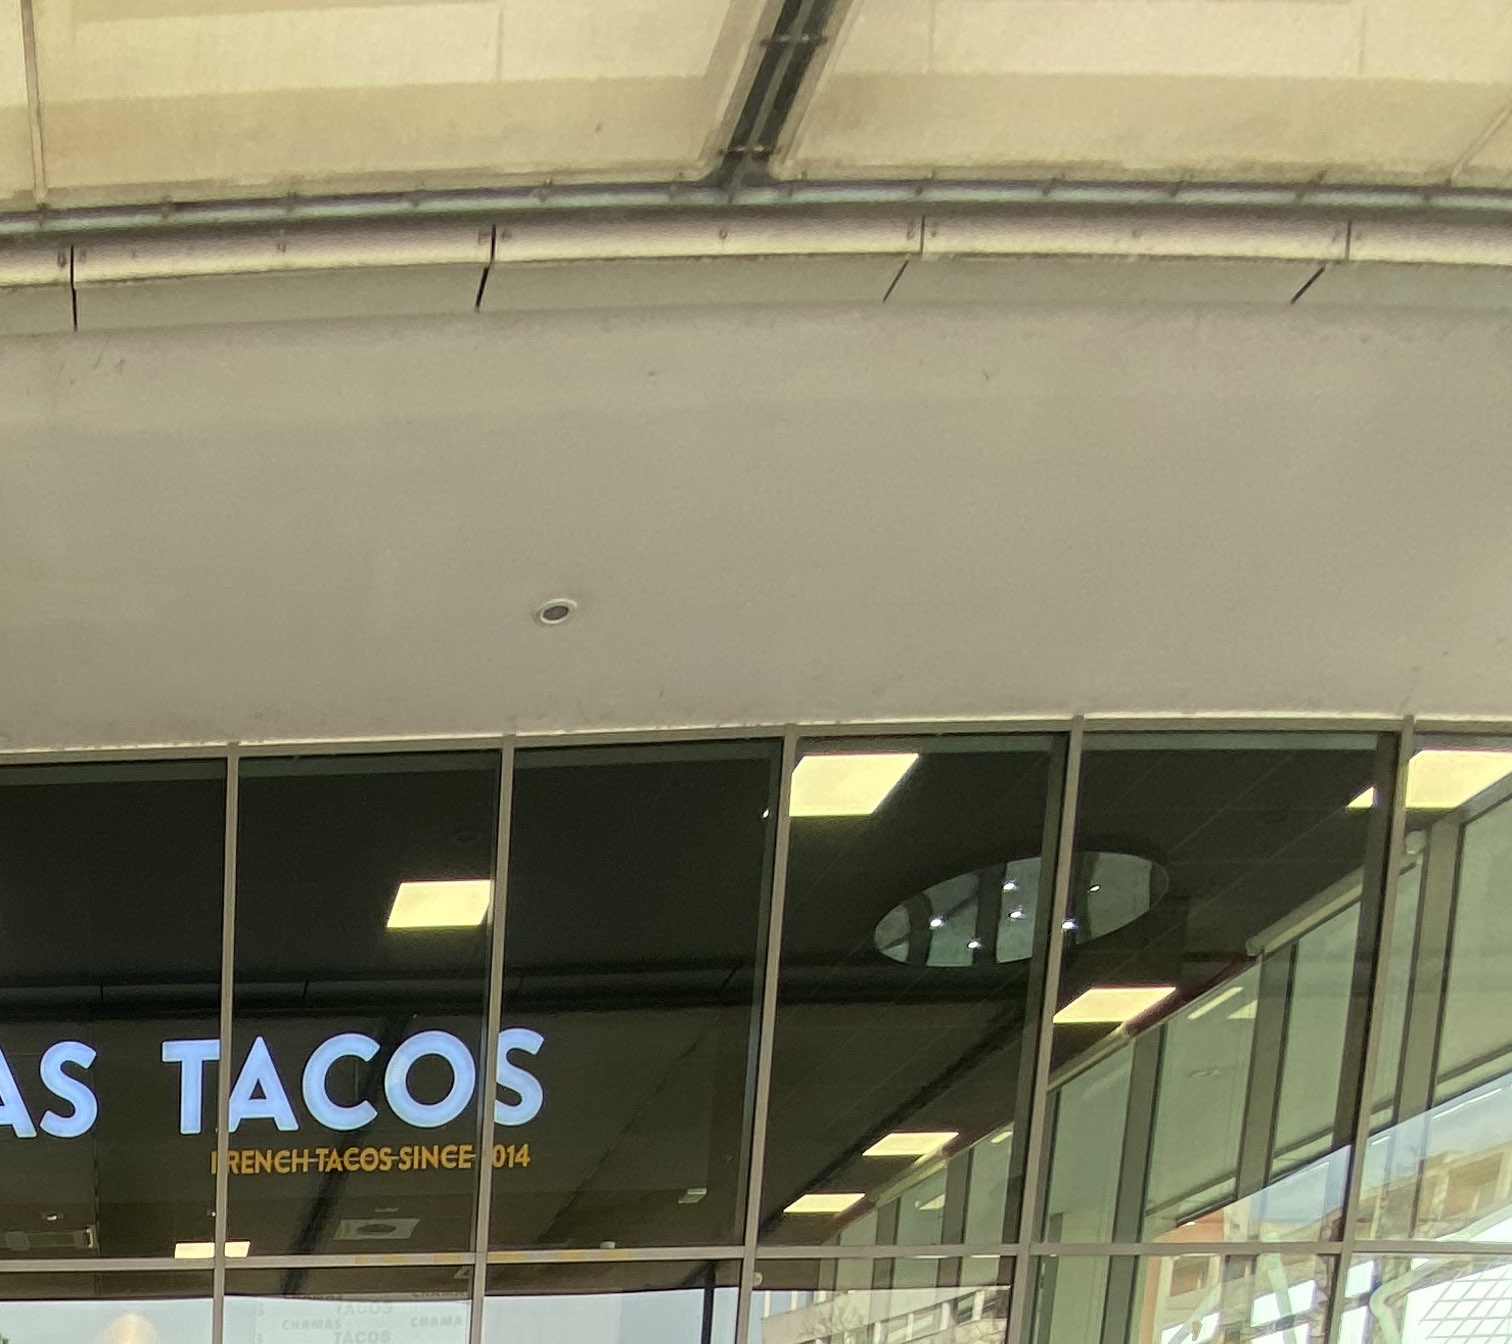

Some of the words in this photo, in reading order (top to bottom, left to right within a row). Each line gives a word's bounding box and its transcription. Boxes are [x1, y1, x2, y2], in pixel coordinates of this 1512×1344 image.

[159, 1027, 546, 1137] TACOS
[316, 1146, 392, 1173] TACOS
[399, 1144, 472, 1171] SINCE
[491, 1143, 531, 1168] 014
